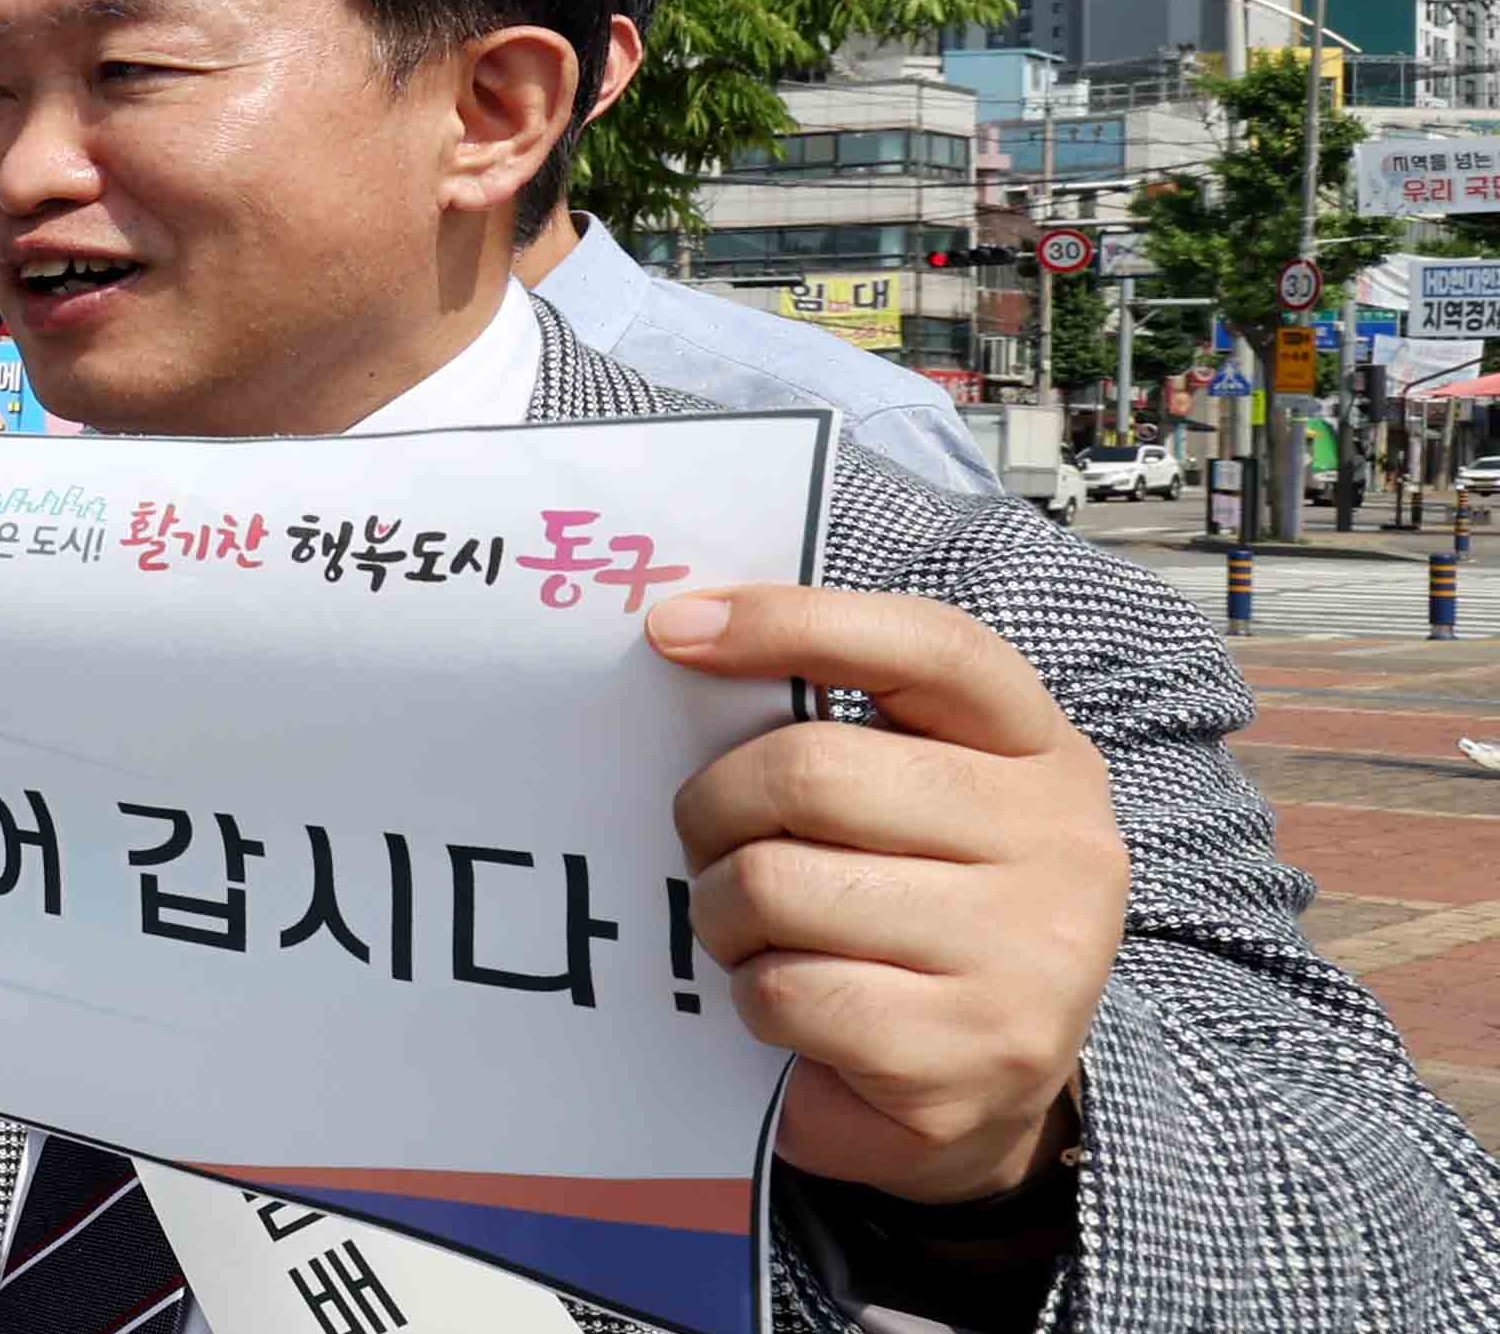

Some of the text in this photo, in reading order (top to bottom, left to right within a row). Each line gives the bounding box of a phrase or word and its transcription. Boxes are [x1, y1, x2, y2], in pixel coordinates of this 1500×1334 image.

[1393, 151, 1493, 172] 지역을 넘는
[1403, 177, 1453, 203] 우리
[1049, 241, 1081, 261] 30
[26, 521, 107, 565] 도시!
[118, 500, 270, 573] 활기찬
[284, 513, 506, 593] 행복도시
[514, 508, 691, 614] 동구
